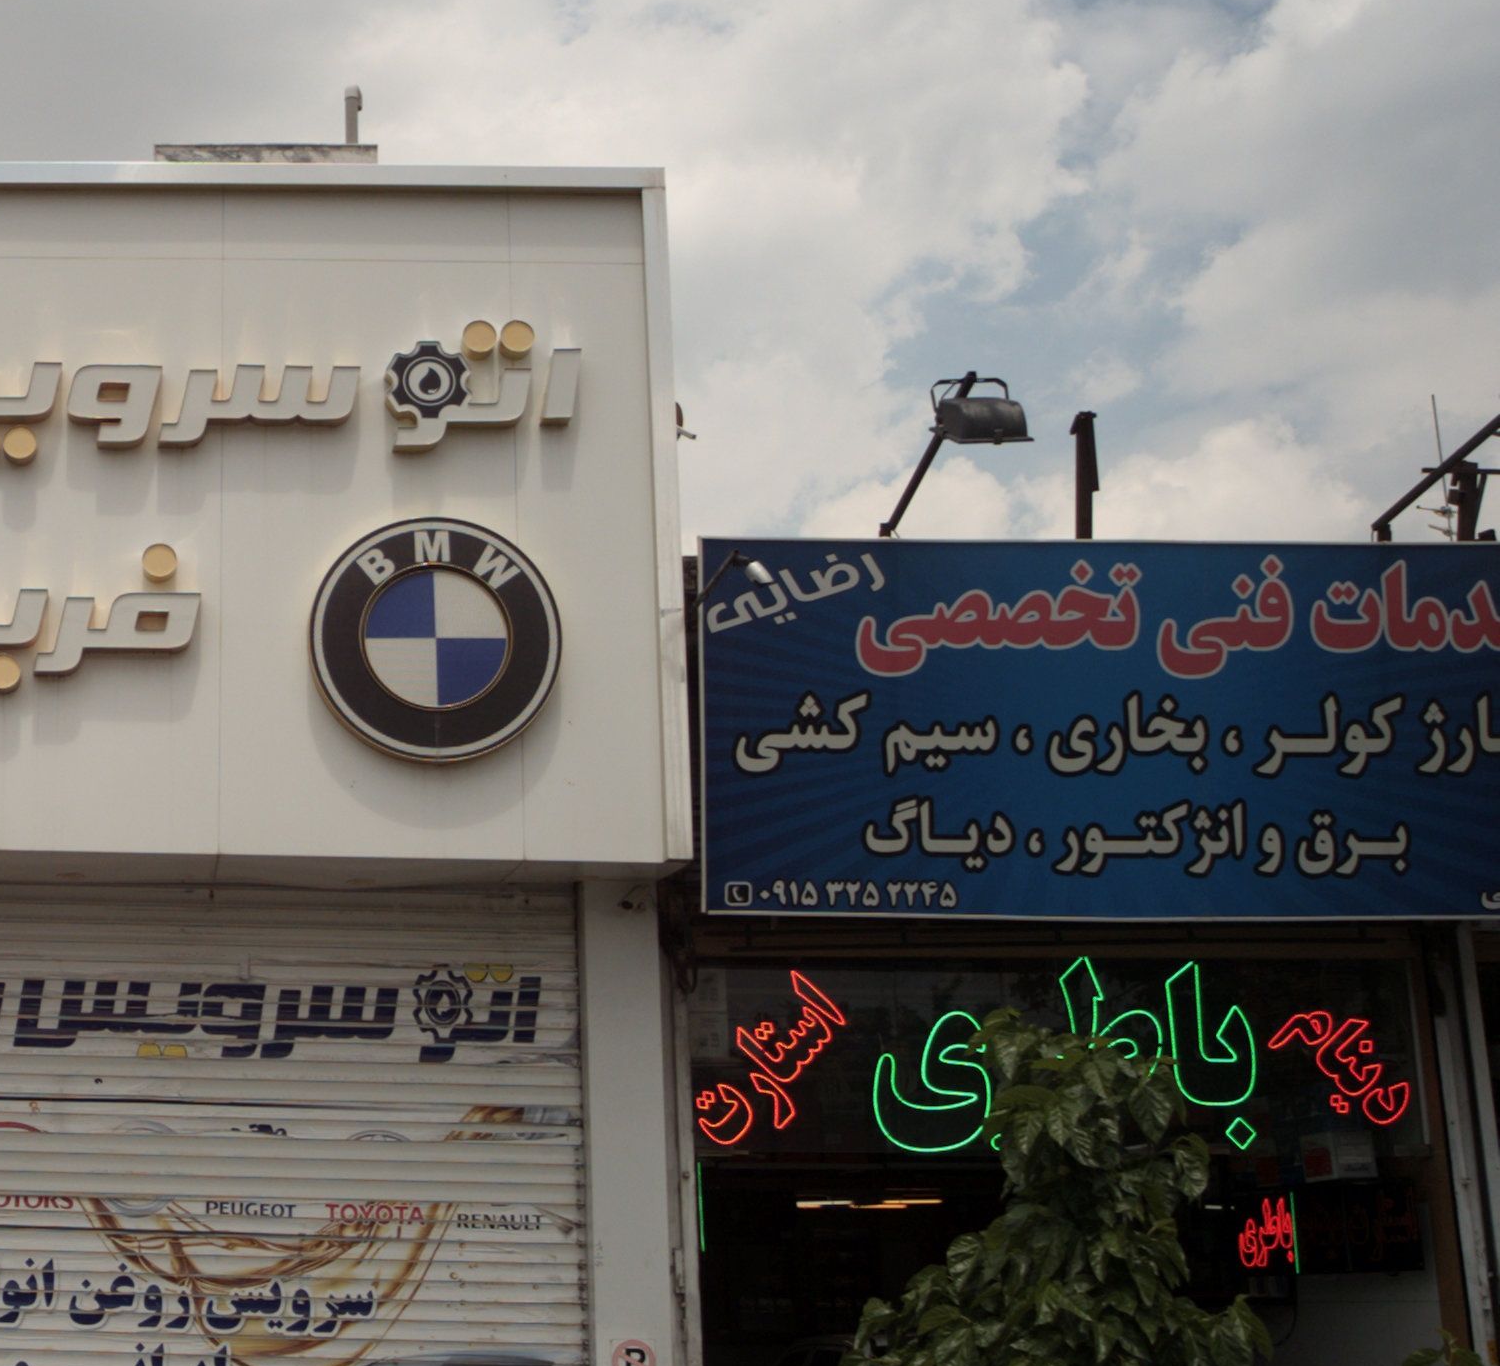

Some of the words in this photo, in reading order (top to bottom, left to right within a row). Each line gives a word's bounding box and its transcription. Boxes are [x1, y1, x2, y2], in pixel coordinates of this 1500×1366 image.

[356, 530, 521, 590] BMW
[855, 559, 1143, 678] تخصصی
[1157, 554, 1294, 679] فنی
[1310, 559, 1500, 653] دمات
[734, 690, 871, 774] کشی
[882, 716, 998, 776] سیم
[1047, 690, 1208, 774] بخاری
[1252, 691, 1404, 777] کولر
[1415, 694, 1500, 774] ارژ
[863, 795, 1016, 871] دیاگ
[1051, 798, 1245, 877] انژکتور
[1254, 824, 1285, 875] و
[1296, 809, 1409, 878] برق
[759, 878, 819, 907] ۰۹۱۵
[825, 879, 880, 907] ۳۲۵
[886, 880, 958, 909] ۲۲۴۵
[13, 979, 399, 1059] سرویس
[696, 968, 847, 1146] استارت
[873, 956, 1258, 1152] باطی
[1268, 1011, 1410, 1125] دینام
[205, 1200, 296, 1219] PEUGEOT
[325, 1203, 425, 1225] TOYOTA
[456, 1213, 543, 1231] RENAULT
[69, 1261, 192, 1330] روغن
[206, 1278, 377, 1334] سرویس
